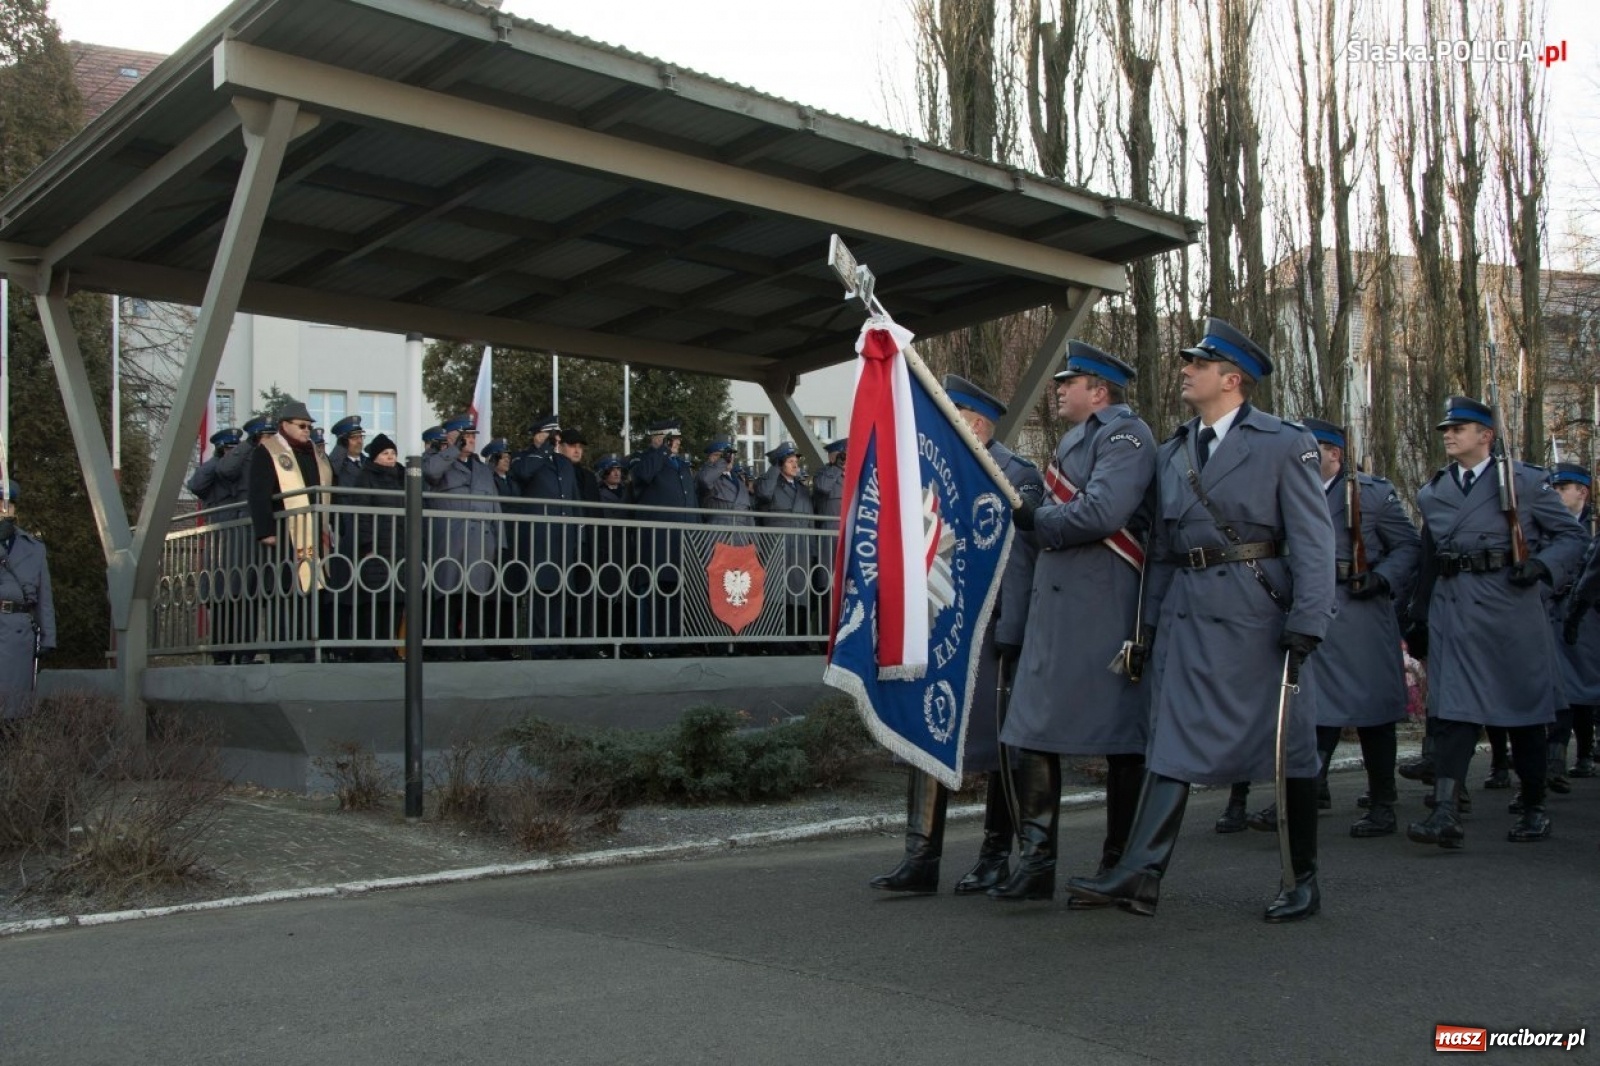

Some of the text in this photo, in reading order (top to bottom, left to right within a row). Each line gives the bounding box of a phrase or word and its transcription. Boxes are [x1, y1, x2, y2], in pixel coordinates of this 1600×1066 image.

[918, 432, 960, 509] POLICJI
[1110, 433, 1141, 448] POLICJA
[933, 537, 966, 669] KATOWICE
